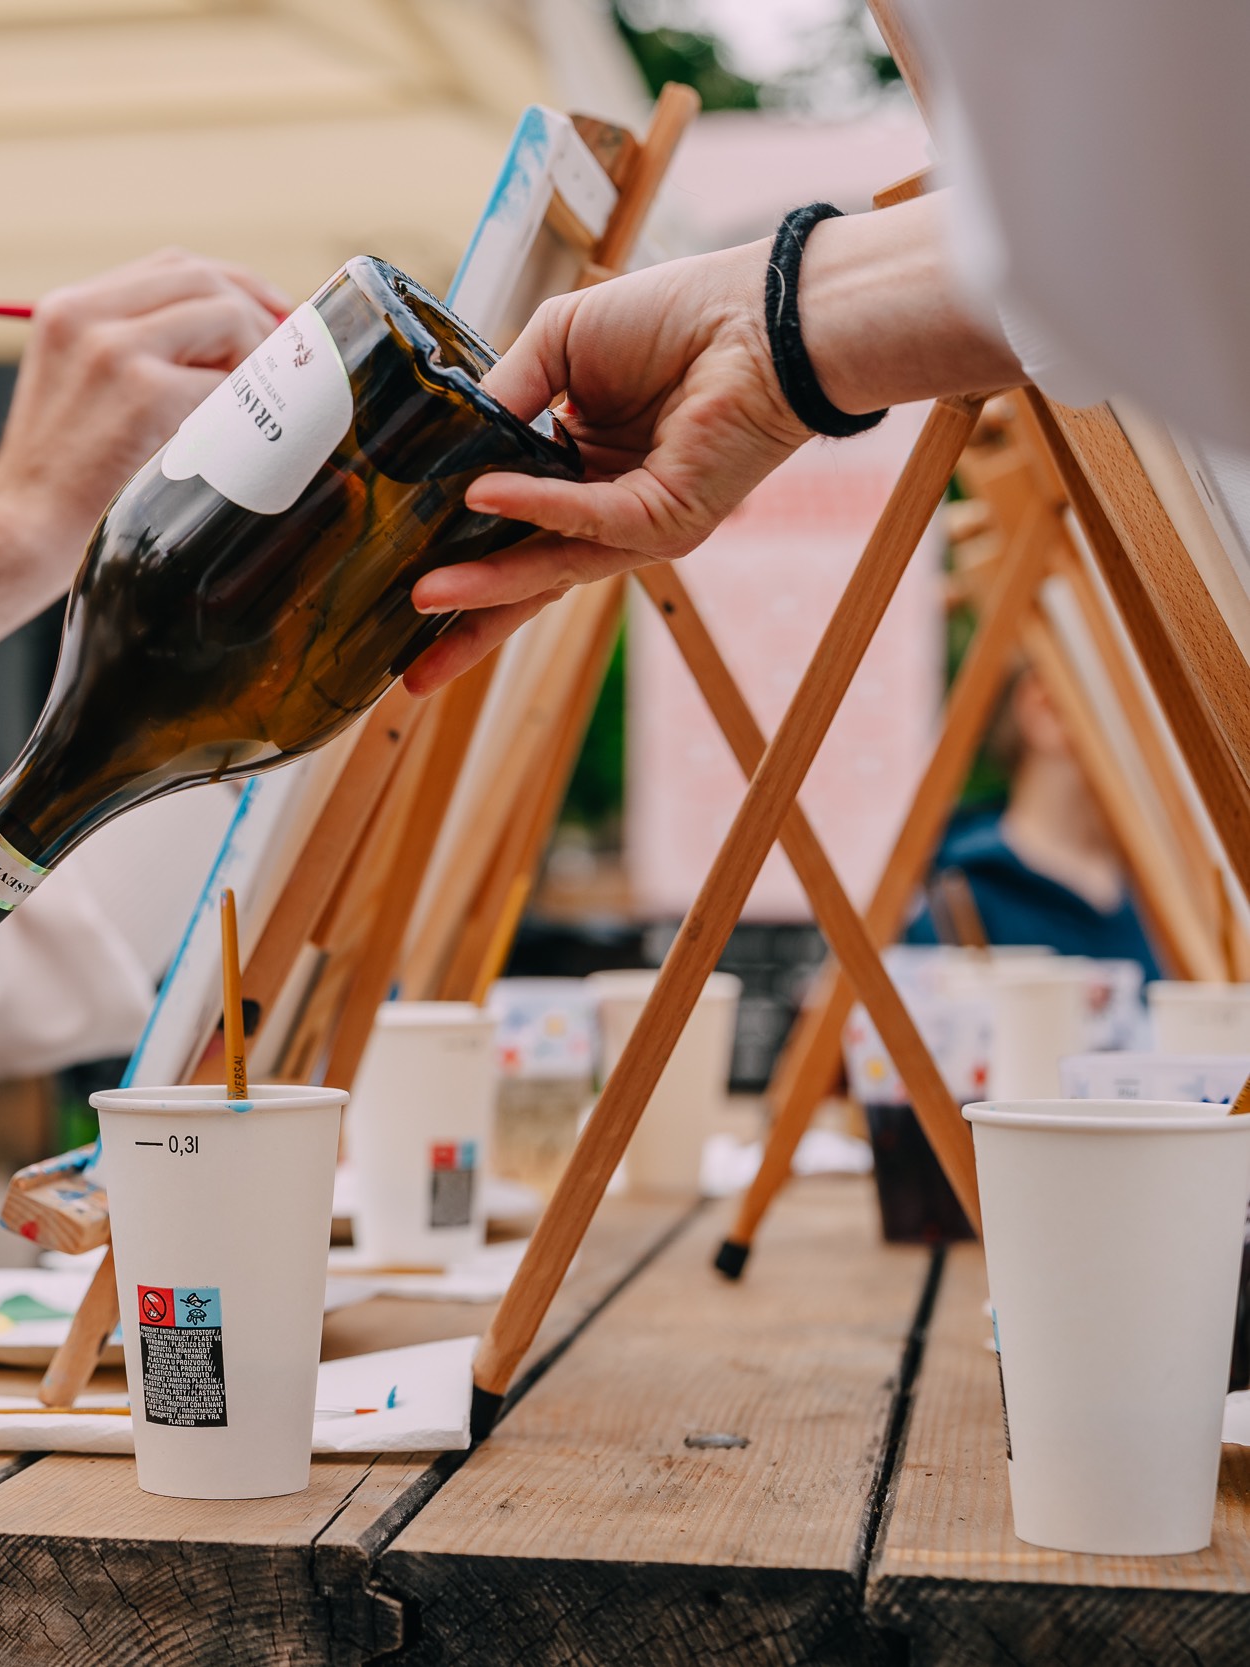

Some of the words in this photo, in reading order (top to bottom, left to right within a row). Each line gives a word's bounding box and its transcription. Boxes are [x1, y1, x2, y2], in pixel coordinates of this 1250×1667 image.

[168, 1135, 199, 1156] 0,3l
[147, 1362, 168, 1370] PLASTICA
[145, 1374, 165, 1382] PRODUKT
[144, 1379, 161, 1387] PLASTIC
[146, 1397, 163, 1405] PLASTIC
[153, 1404, 178, 1413] PLASTIQUE
